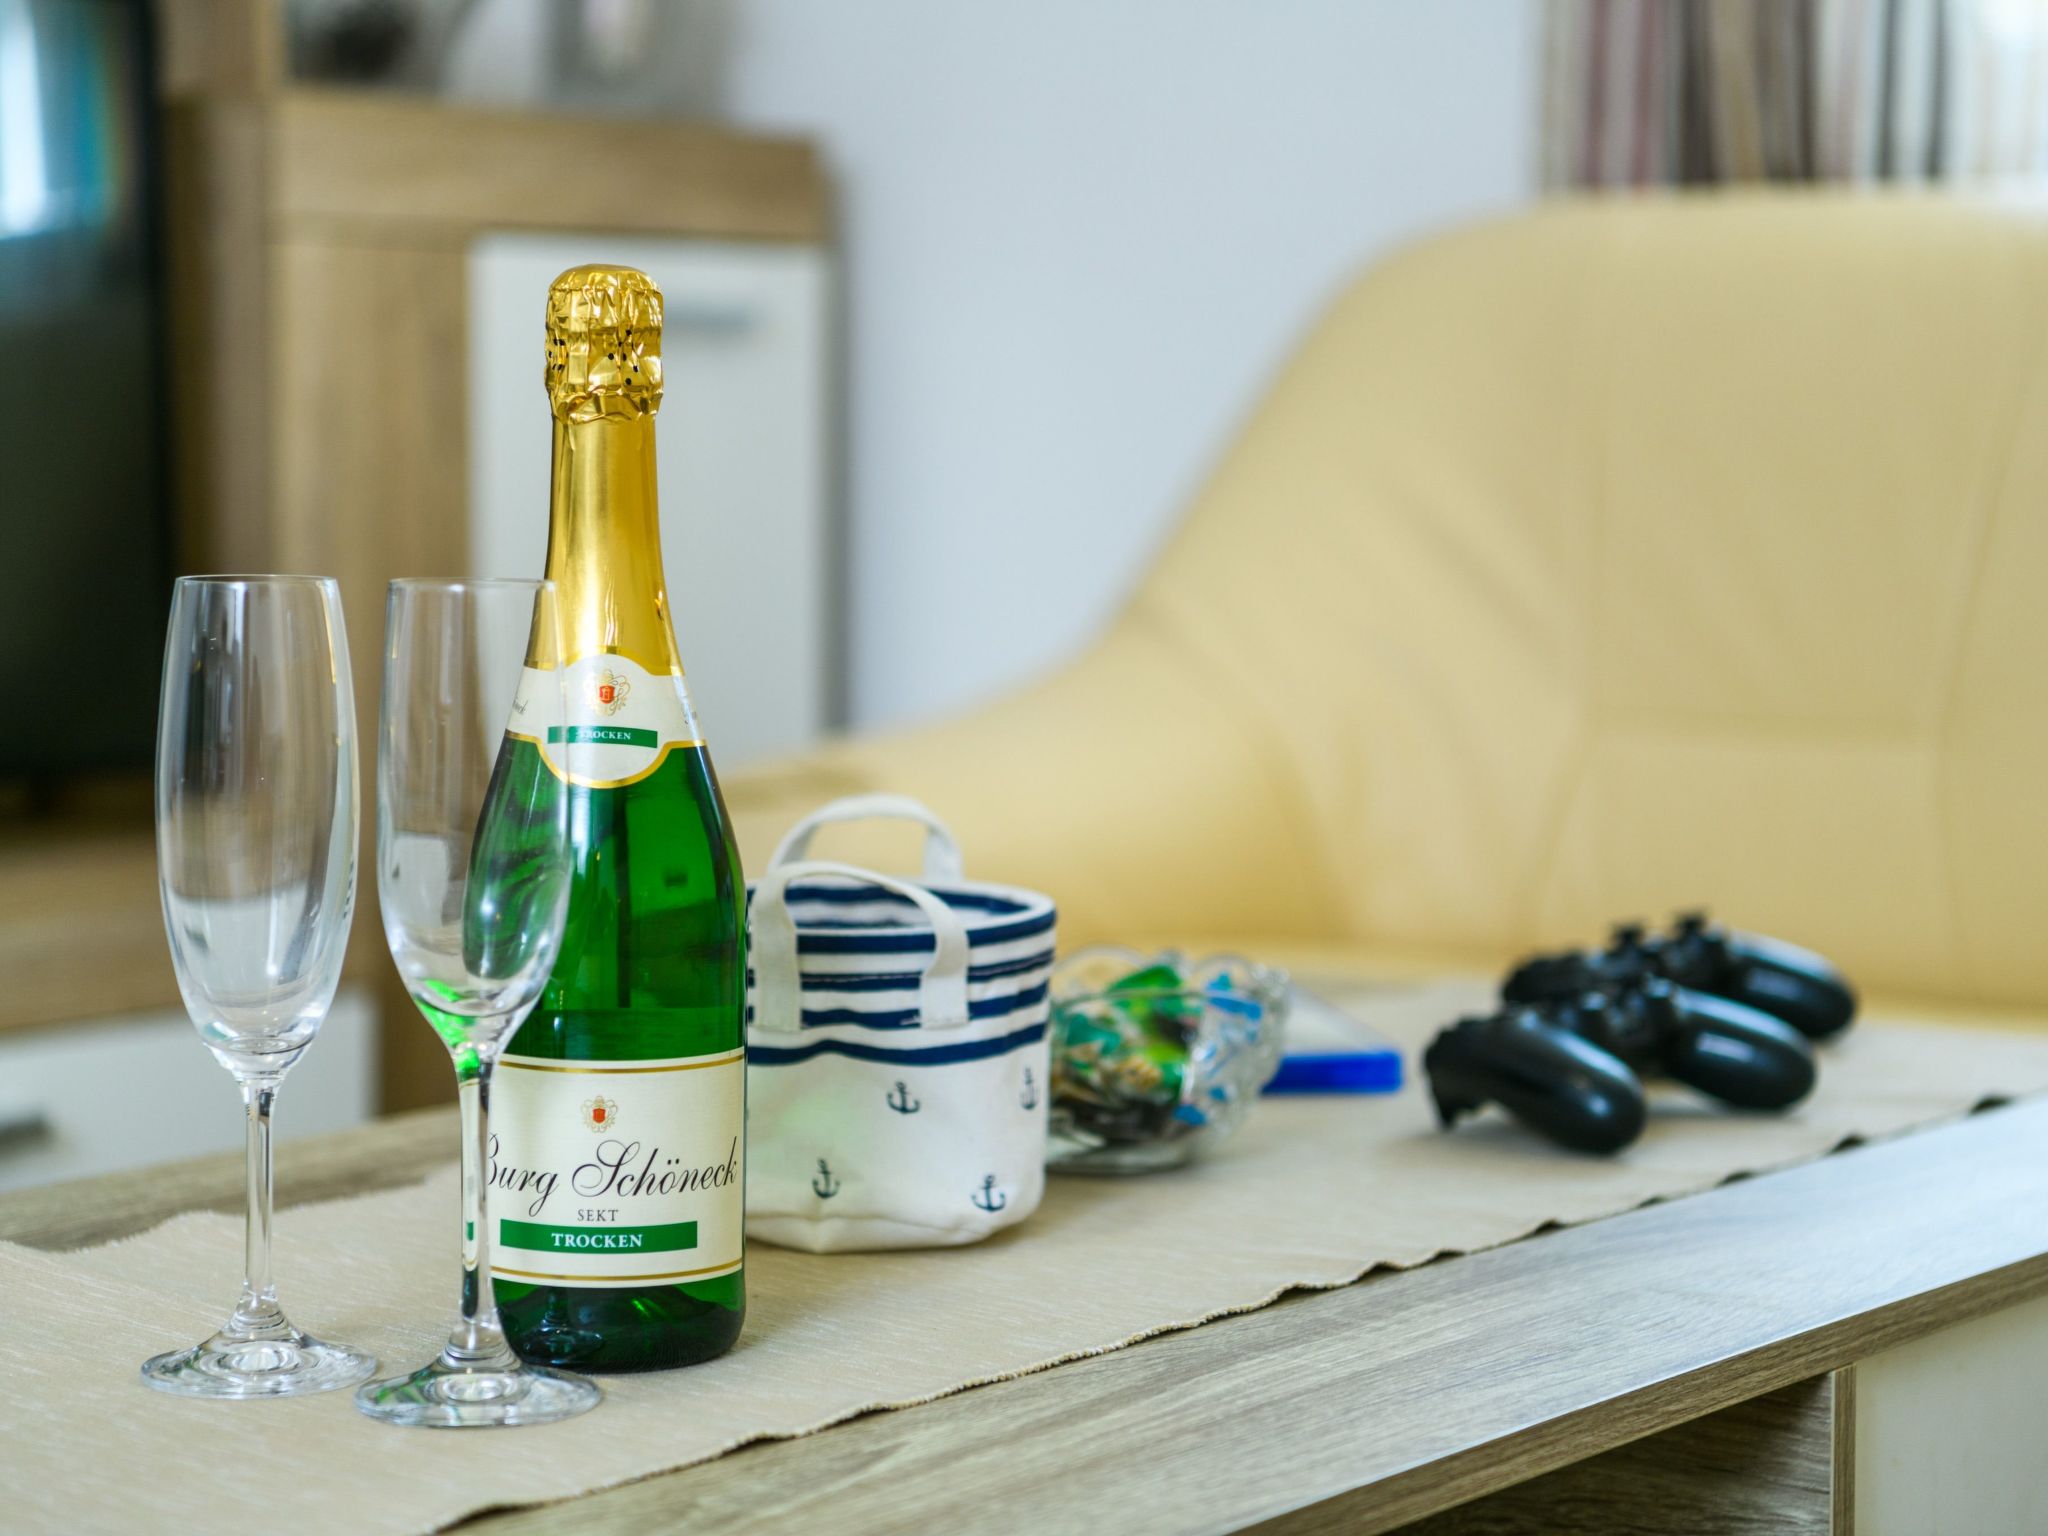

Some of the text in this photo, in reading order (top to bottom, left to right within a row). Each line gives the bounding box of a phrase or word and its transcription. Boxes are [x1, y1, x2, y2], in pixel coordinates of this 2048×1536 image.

[571, 1135, 738, 1198] Schöneck
[576, 1208, 620, 1222] SEKT
[551, 1232, 643, 1248] TROCKEN
